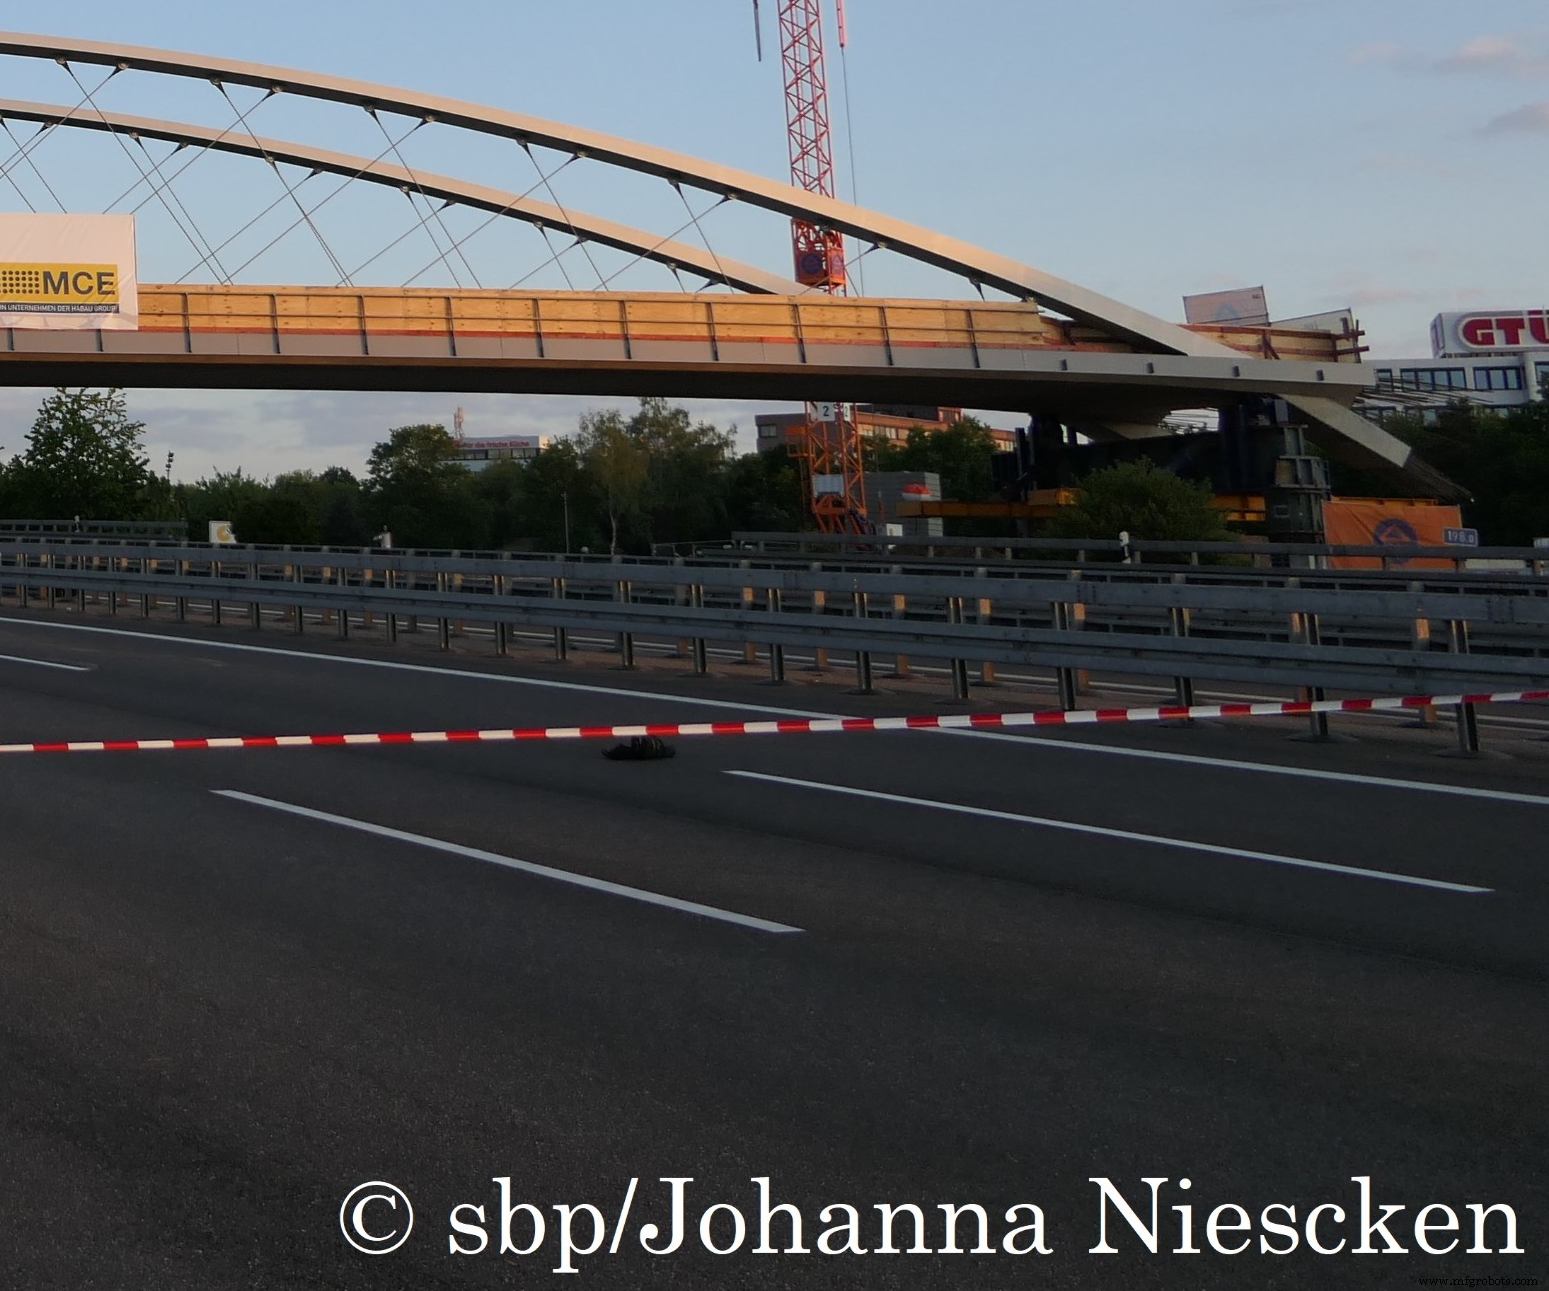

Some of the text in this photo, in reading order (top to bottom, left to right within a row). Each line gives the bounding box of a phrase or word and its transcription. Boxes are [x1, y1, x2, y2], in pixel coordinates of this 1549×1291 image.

[42, 271, 115, 295] MCE
[8, 304, 56, 312] UNTERNEHMEN
[822, 405, 830, 417] 2
